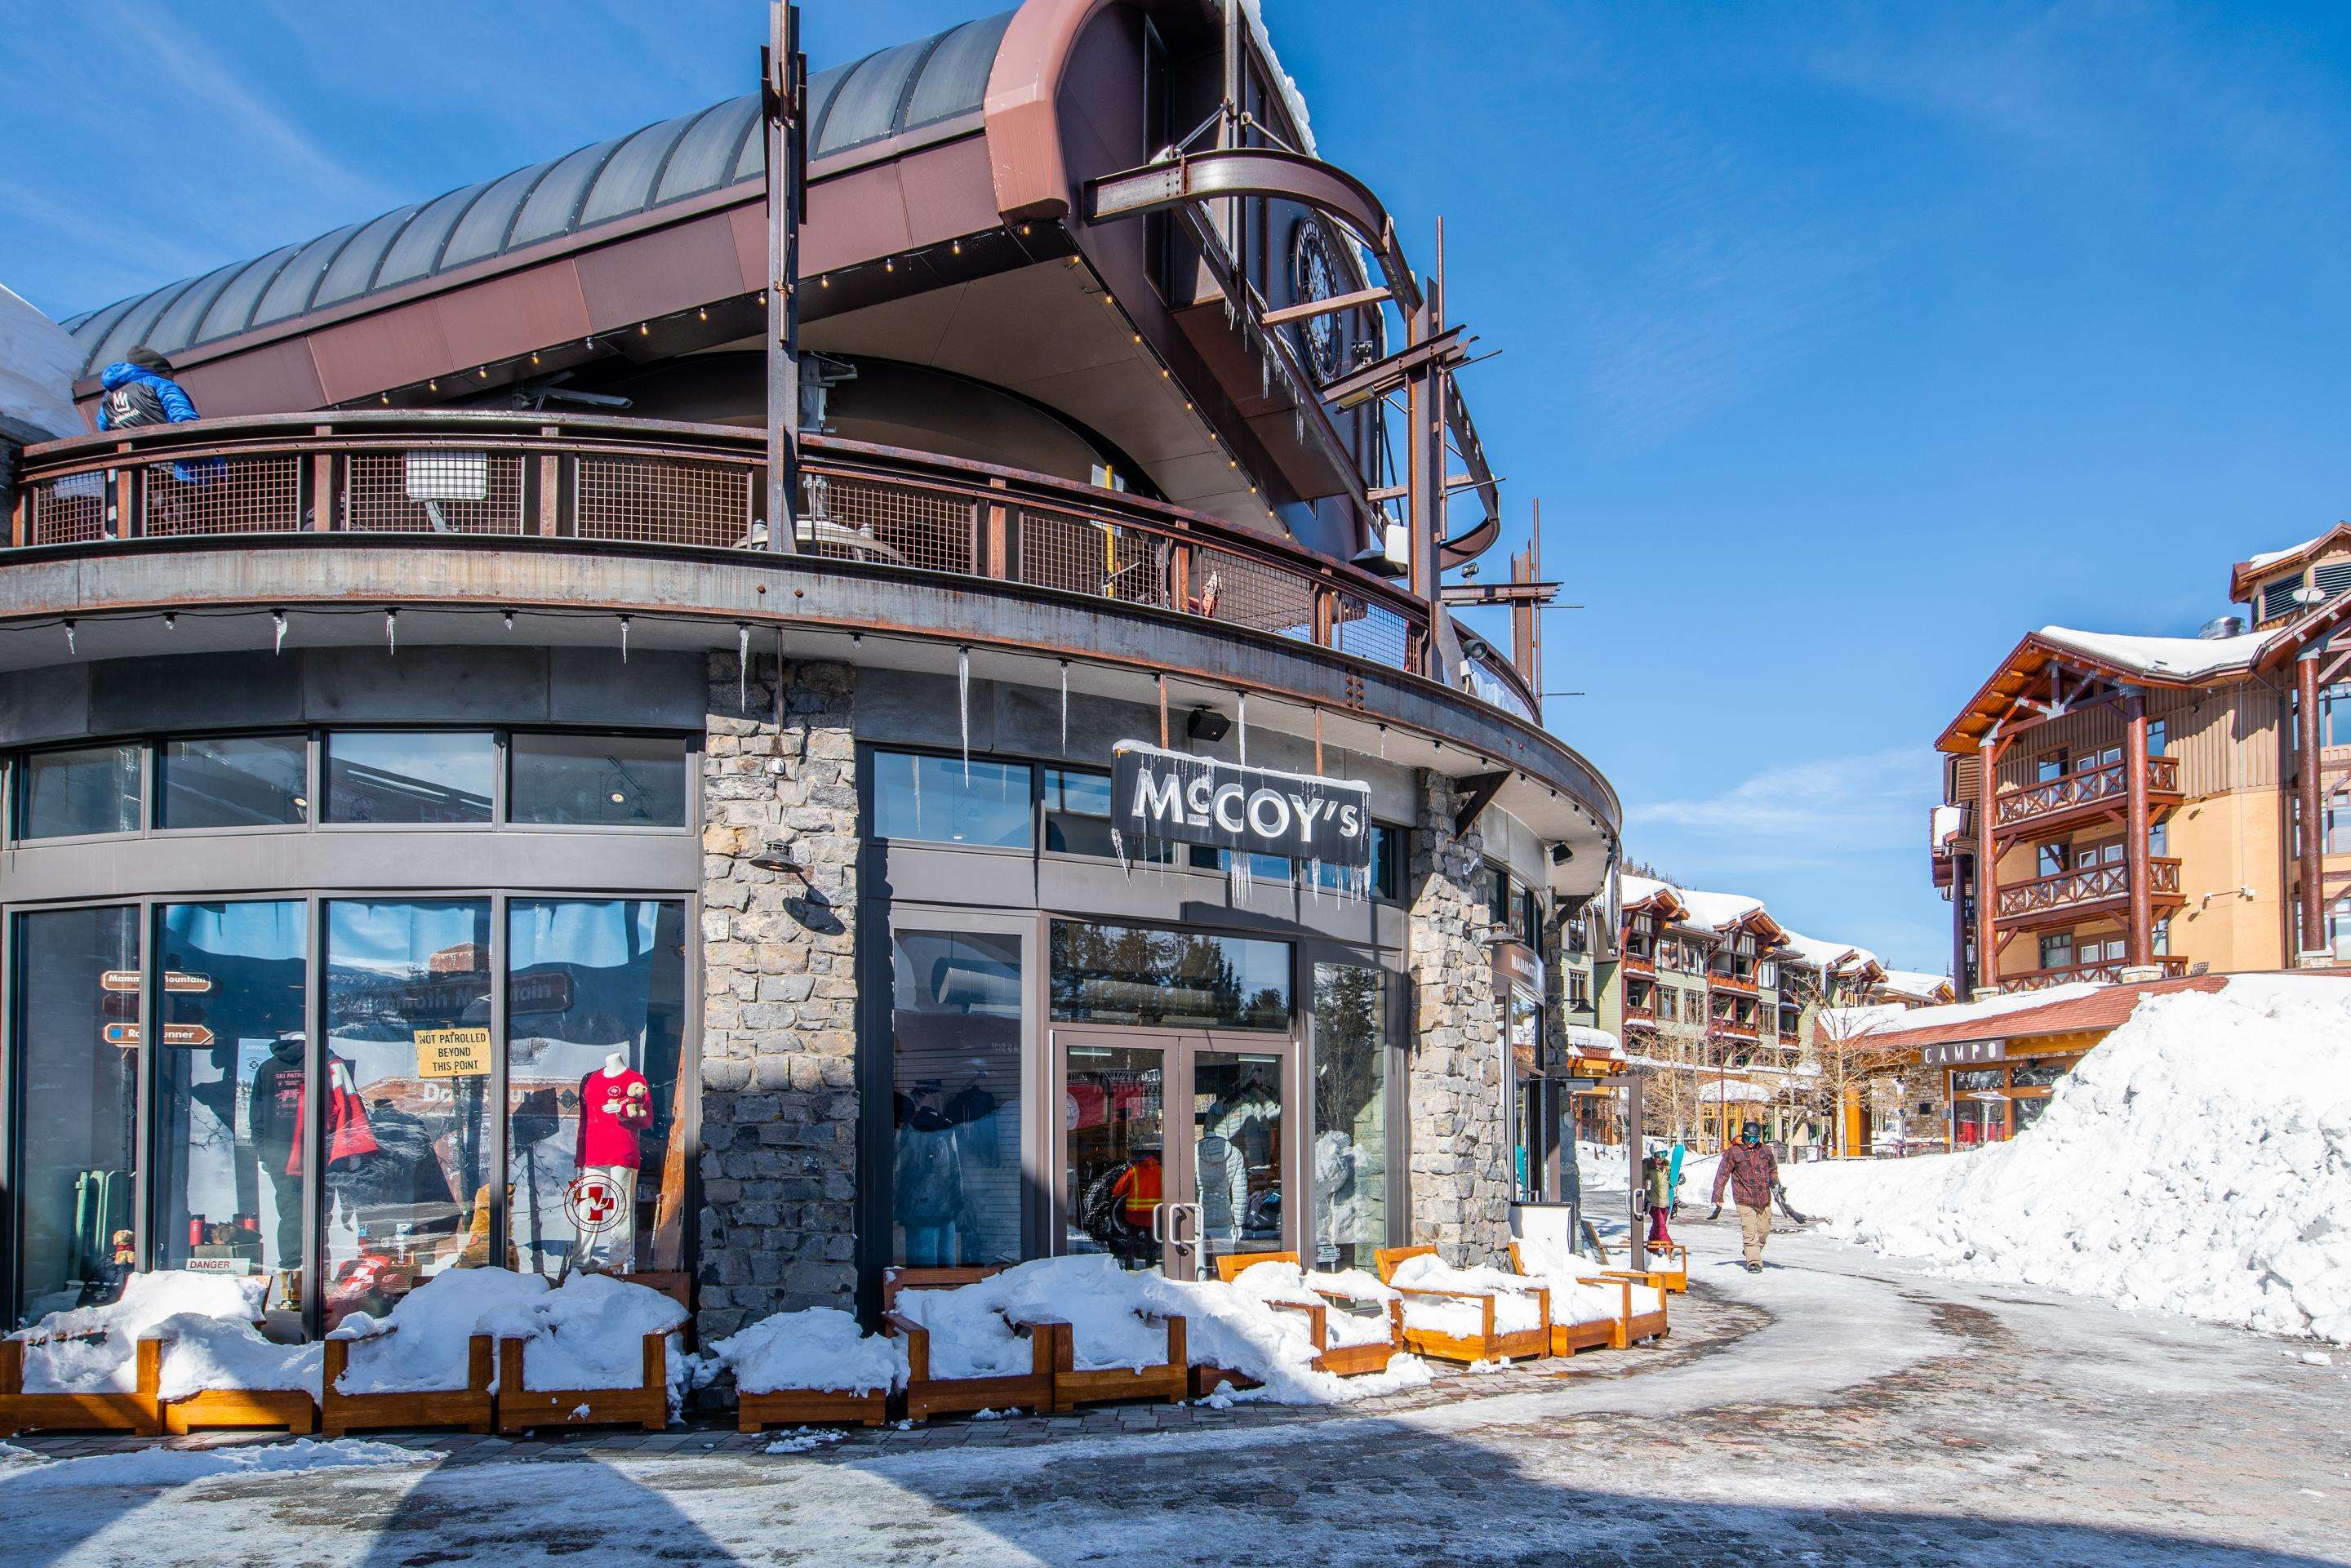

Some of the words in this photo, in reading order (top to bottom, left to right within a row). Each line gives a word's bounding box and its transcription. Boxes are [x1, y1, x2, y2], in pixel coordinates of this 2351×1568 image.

[419, 1034, 436, 1044] NOT
[439, 1033, 487, 1044] PATROLLED
[438, 1047, 471, 1058] BEYOND
[1924, 1042, 1998, 1064] CAMPO
[432, 1061, 451, 1071] THIS
[454, 1059, 478, 1070] POINT
[189, 1260, 230, 1268] DANGER
